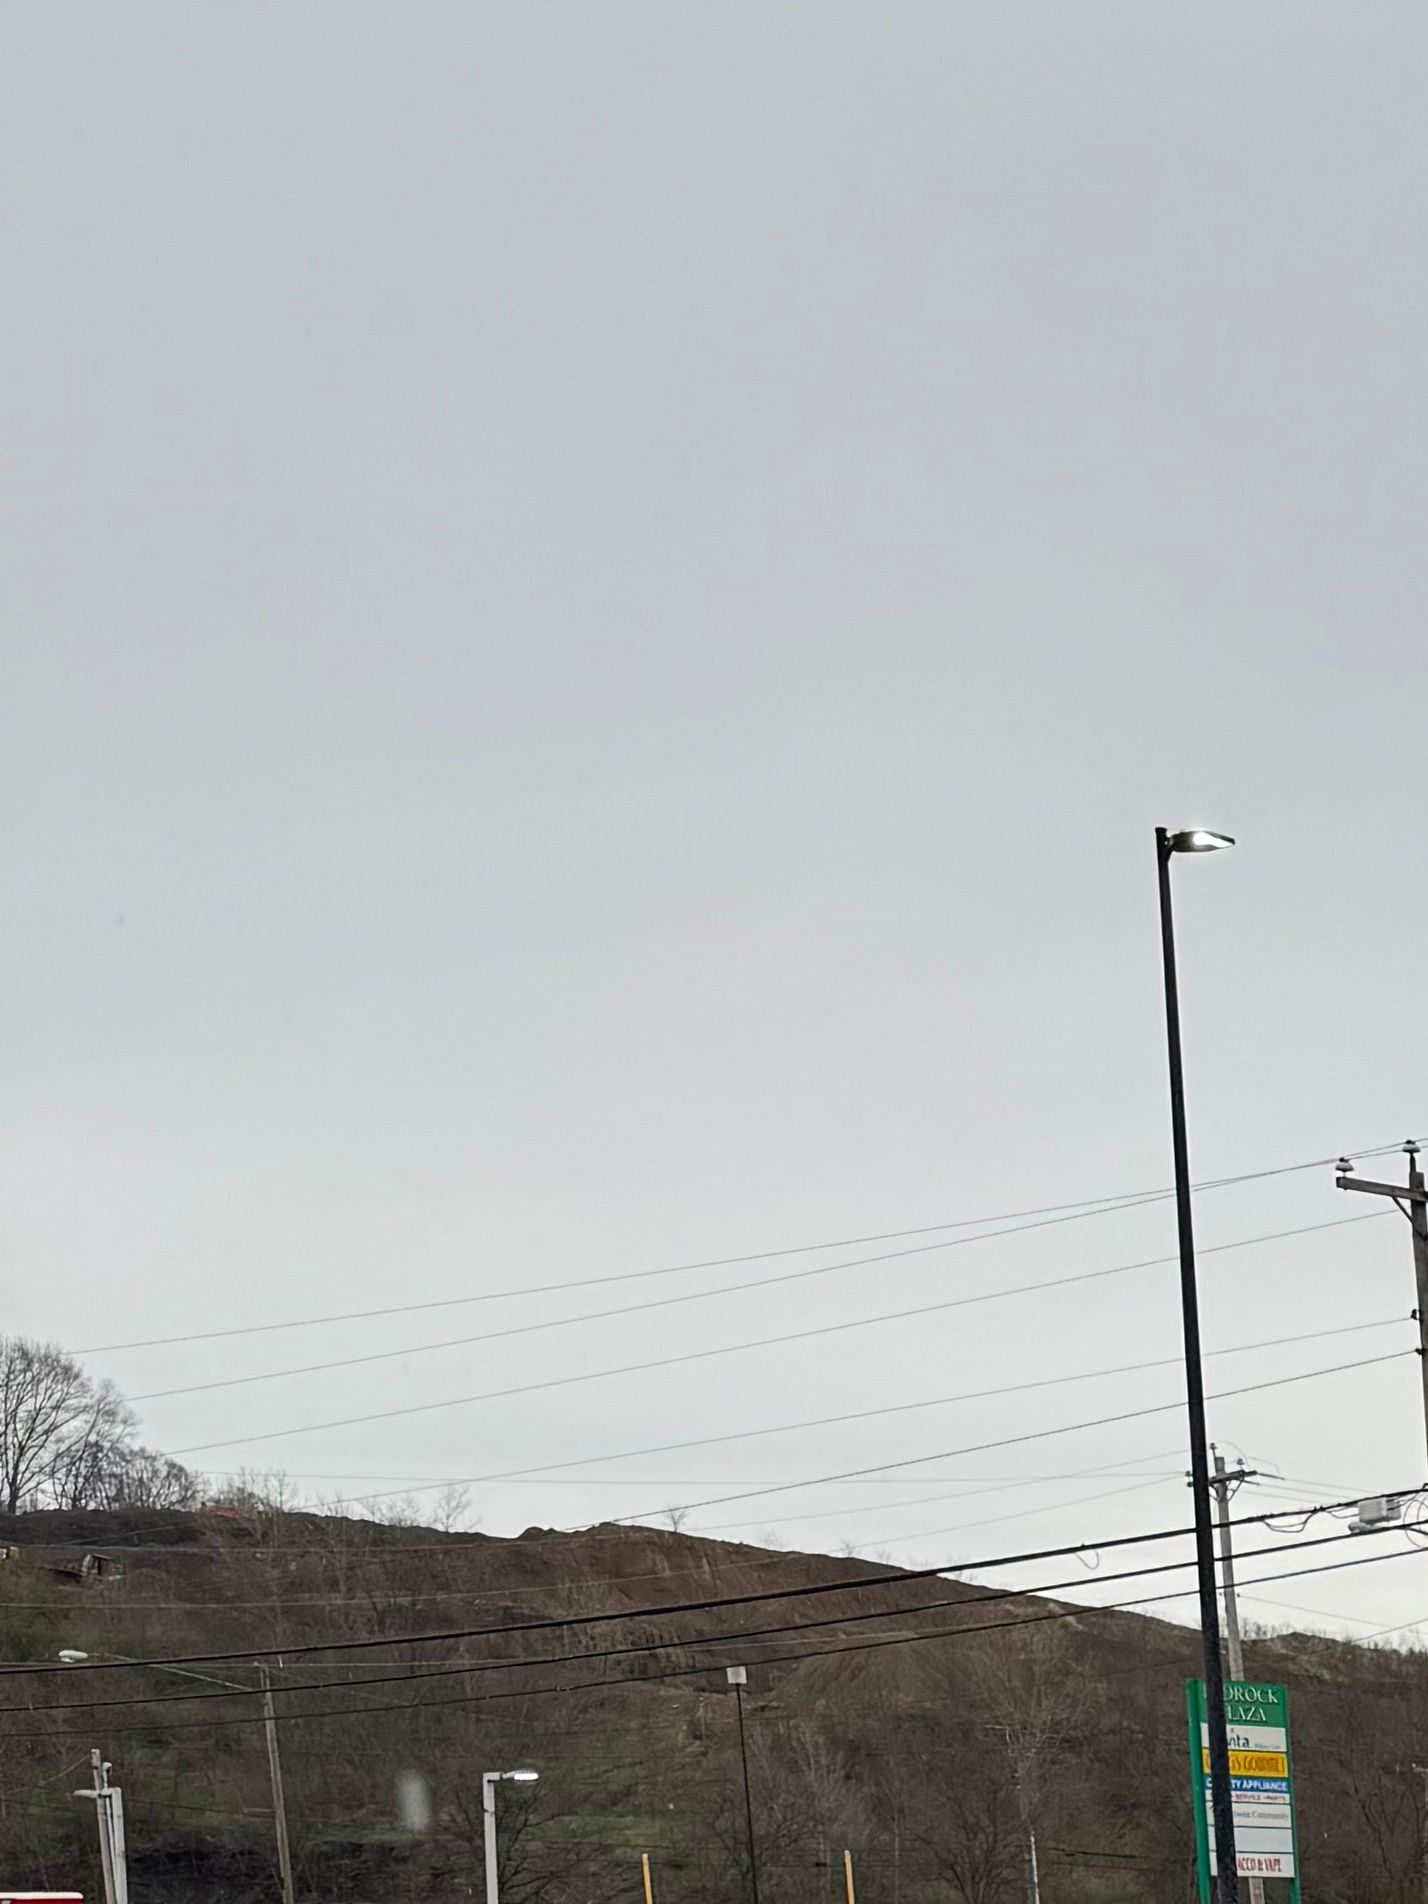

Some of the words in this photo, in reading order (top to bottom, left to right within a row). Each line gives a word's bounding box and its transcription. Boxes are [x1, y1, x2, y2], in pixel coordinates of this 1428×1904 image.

[1203, 1683, 1279, 1704] DROCK
[1225, 1702, 1267, 1721] LAZA
[1243, 1779, 1288, 1791] APPLIANCE
